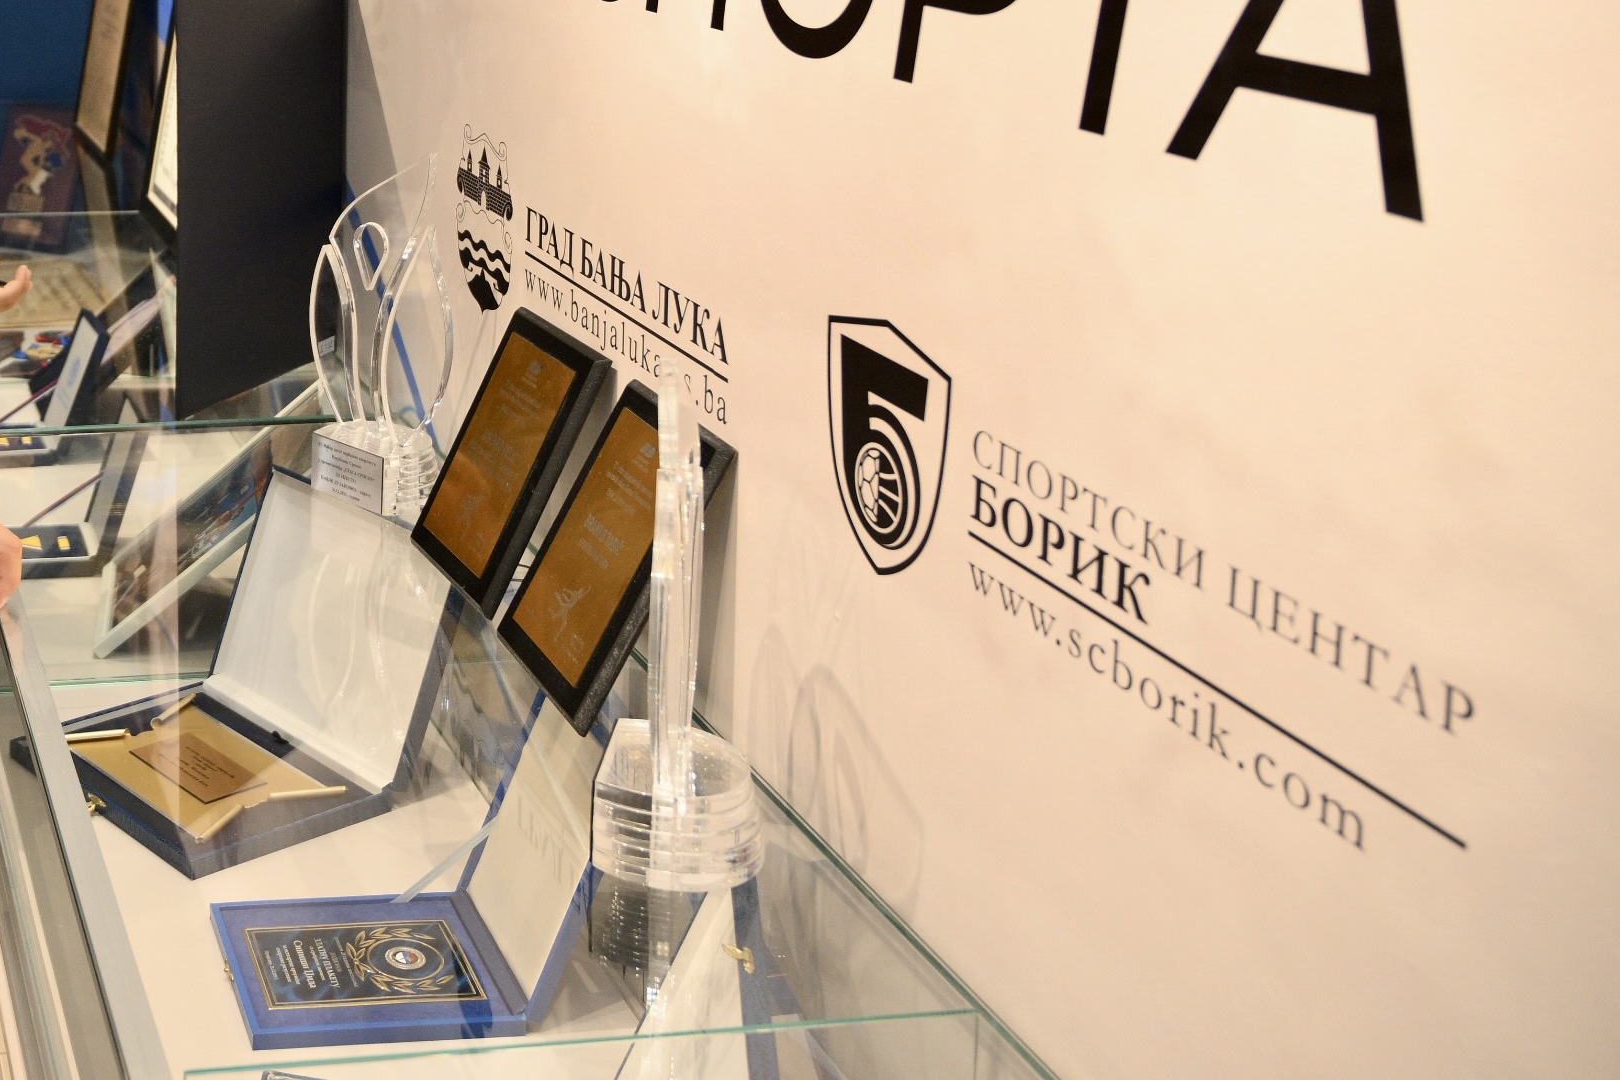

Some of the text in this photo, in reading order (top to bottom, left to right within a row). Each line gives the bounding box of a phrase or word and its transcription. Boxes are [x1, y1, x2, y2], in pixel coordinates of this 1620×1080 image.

[525, 205, 729, 366] ГРАД БАЊА ЛУКА
[525, 268, 728, 425] www.banjalukas.ba
[970, 474, 1151, 625] БОРИК
[971, 429, 1476, 737] СПОРТСКИ ЦЕНТАР
[967, 561, 1367, 851] www.scborik.com
